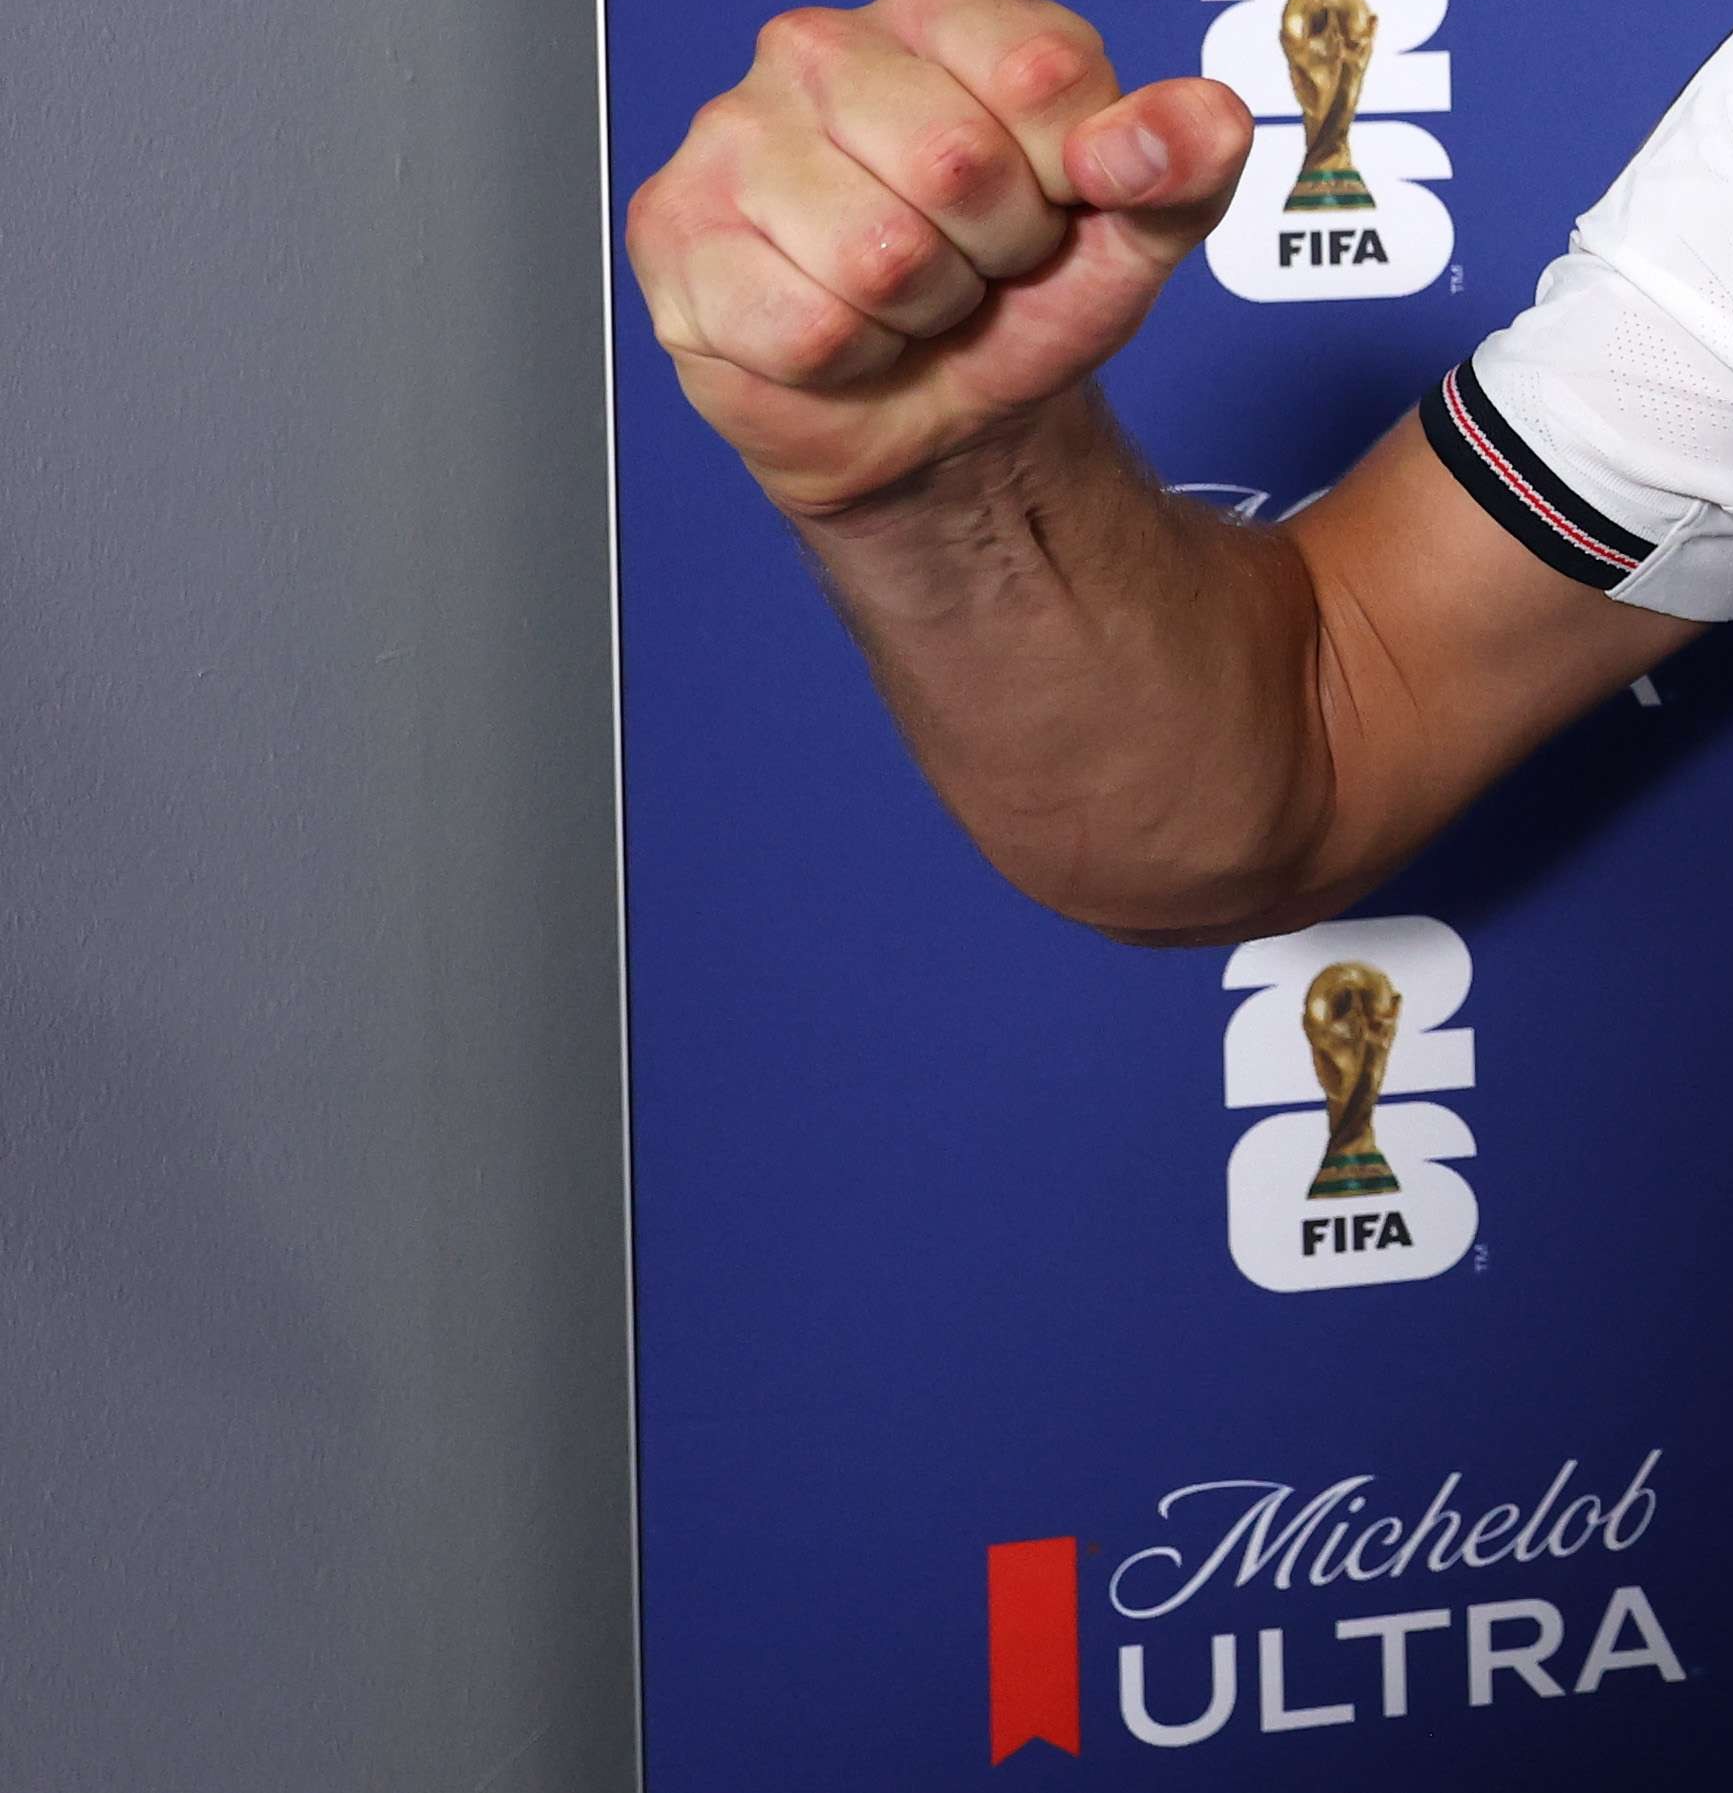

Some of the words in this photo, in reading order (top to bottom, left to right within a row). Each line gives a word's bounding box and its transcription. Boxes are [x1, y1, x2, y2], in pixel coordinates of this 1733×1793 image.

[1278, 228, 1389, 268] FIFA
[1301, 1210, 1414, 1257] FIFA
[1109, 1448, 1663, 1620] Michelob
[1118, 1585, 1687, 1748] ULTRA
